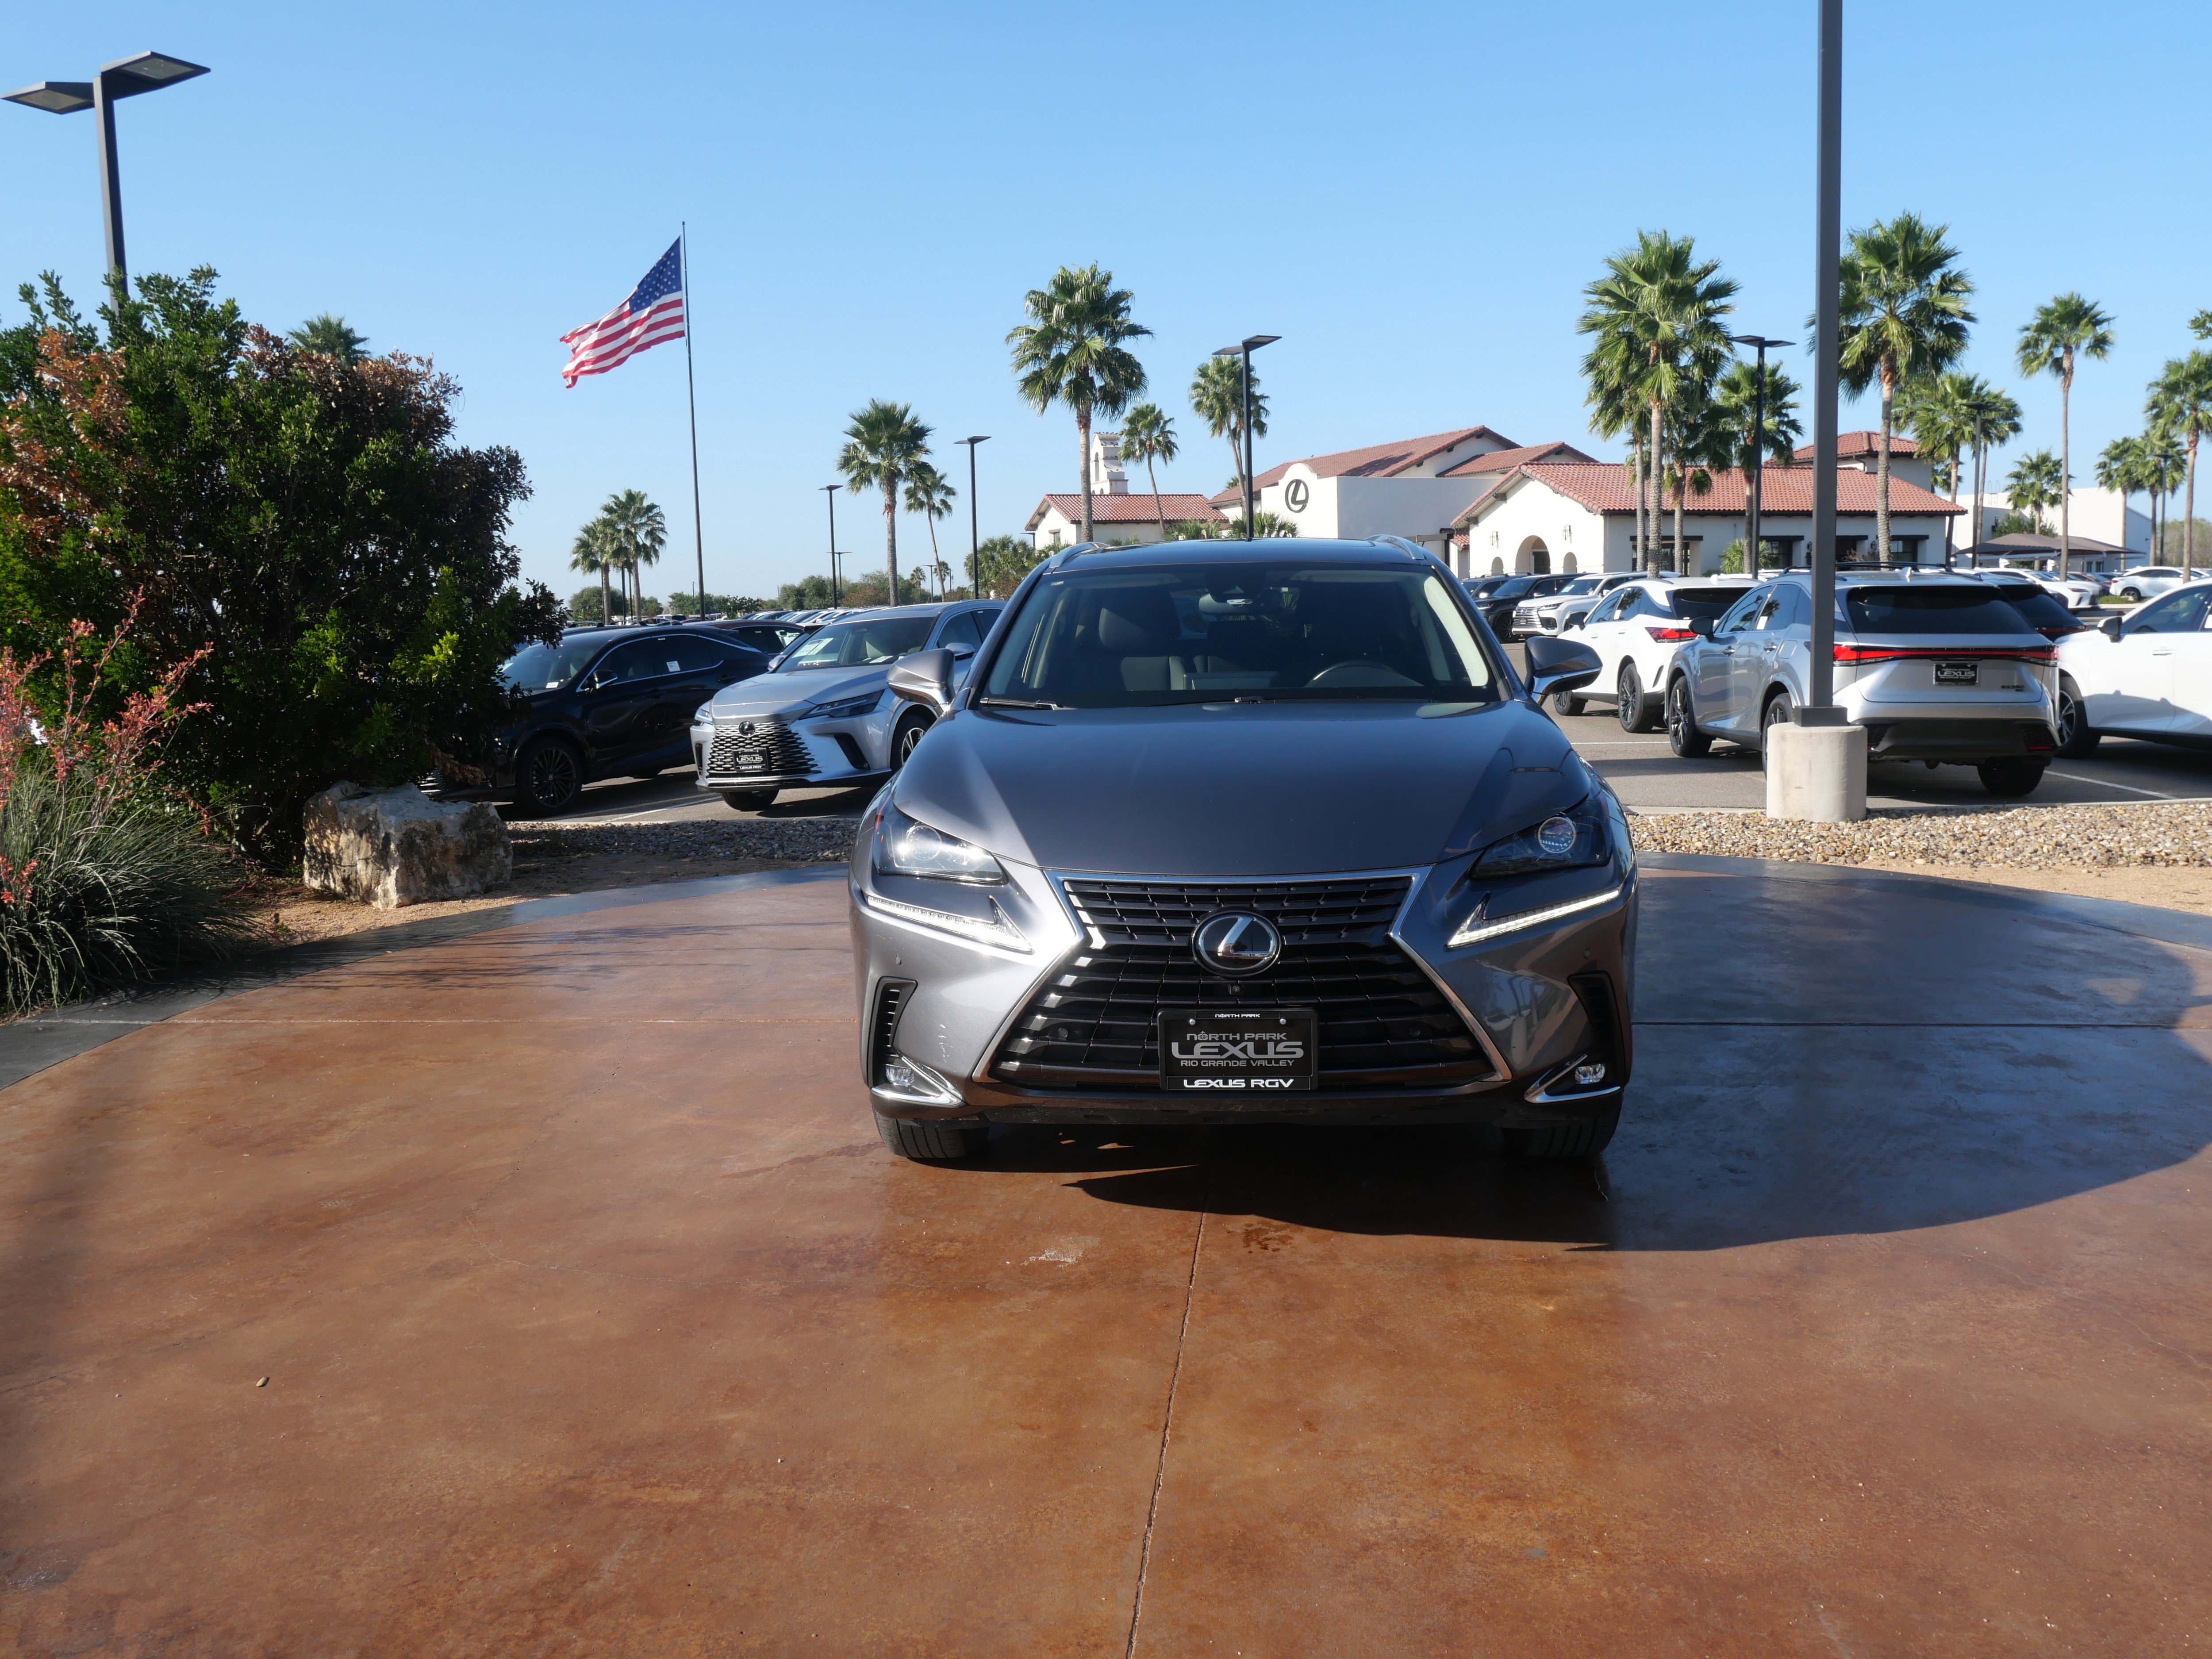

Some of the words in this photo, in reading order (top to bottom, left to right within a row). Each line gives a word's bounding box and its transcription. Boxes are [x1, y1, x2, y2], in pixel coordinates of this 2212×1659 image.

[1187, 1031, 1240, 1041] NORTH
[1171, 1041, 1304, 1059] LEXUS
[1183, 1079, 1246, 1088] LEXUS
[1250, 1079, 1294, 1088] RGV
